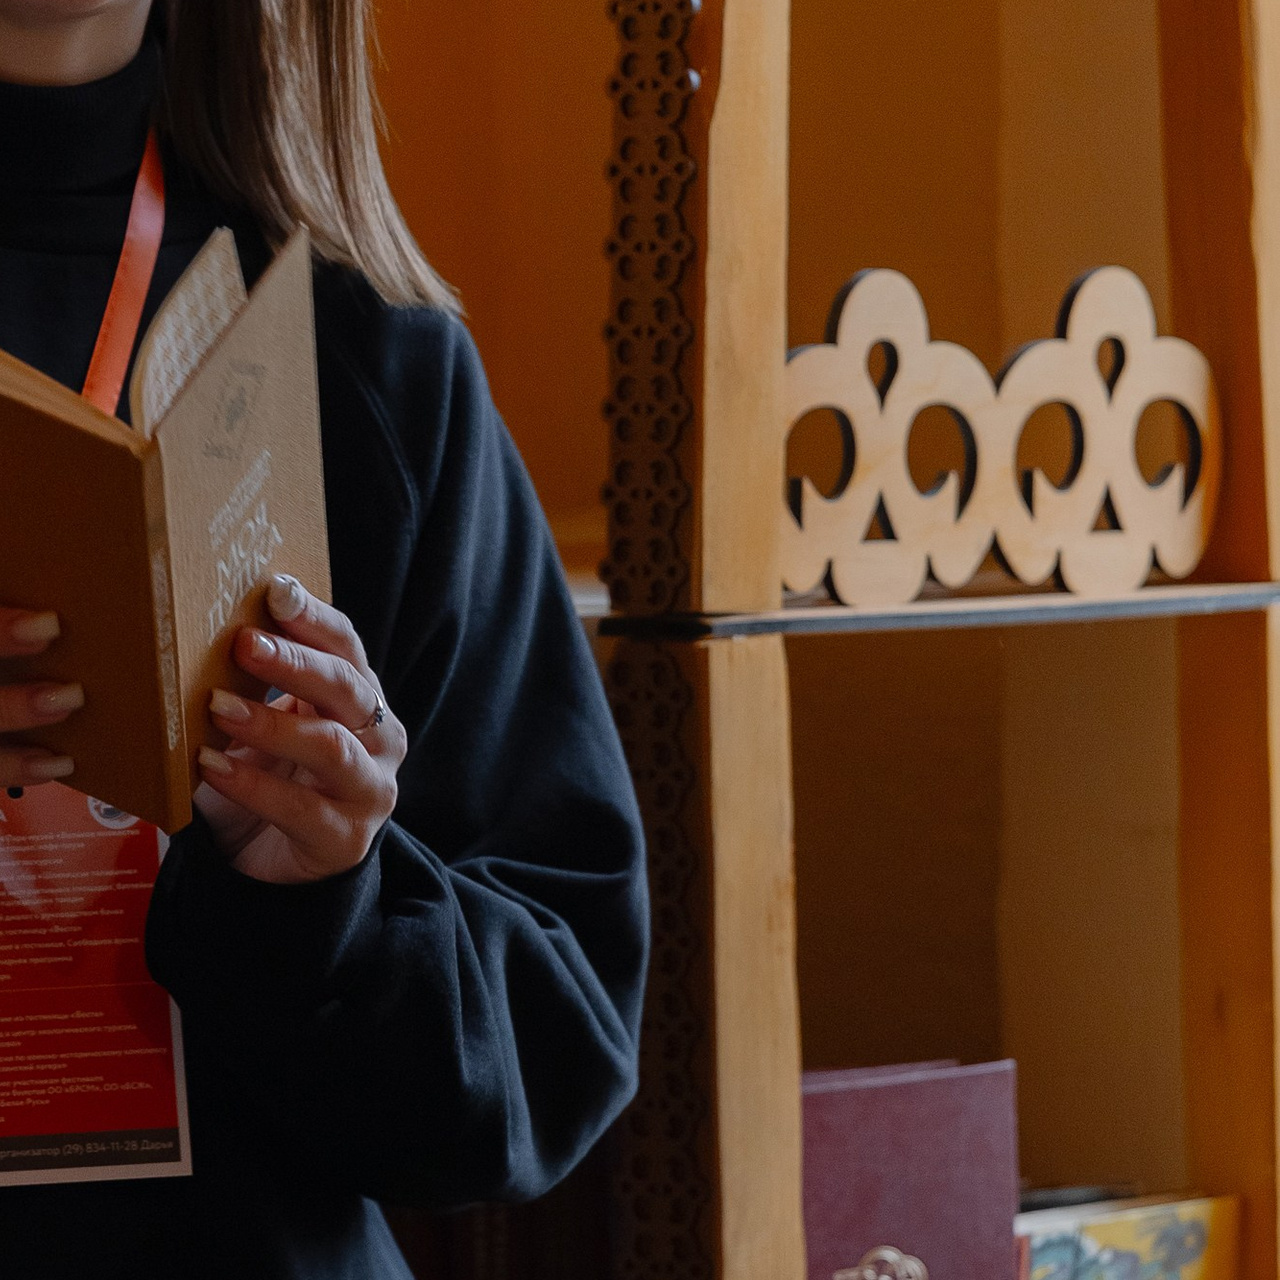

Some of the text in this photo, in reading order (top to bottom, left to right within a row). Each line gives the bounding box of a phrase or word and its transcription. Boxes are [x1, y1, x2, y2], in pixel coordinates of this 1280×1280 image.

[47, 1085, 63, 1094] ОО
[102, 1082, 119, 1091] ОО
[62, 1142, 84, 1156] (29)
[84, 1139, 138, 1154] 834-11-28
[138, 1137, 174, 1151] Дарья
